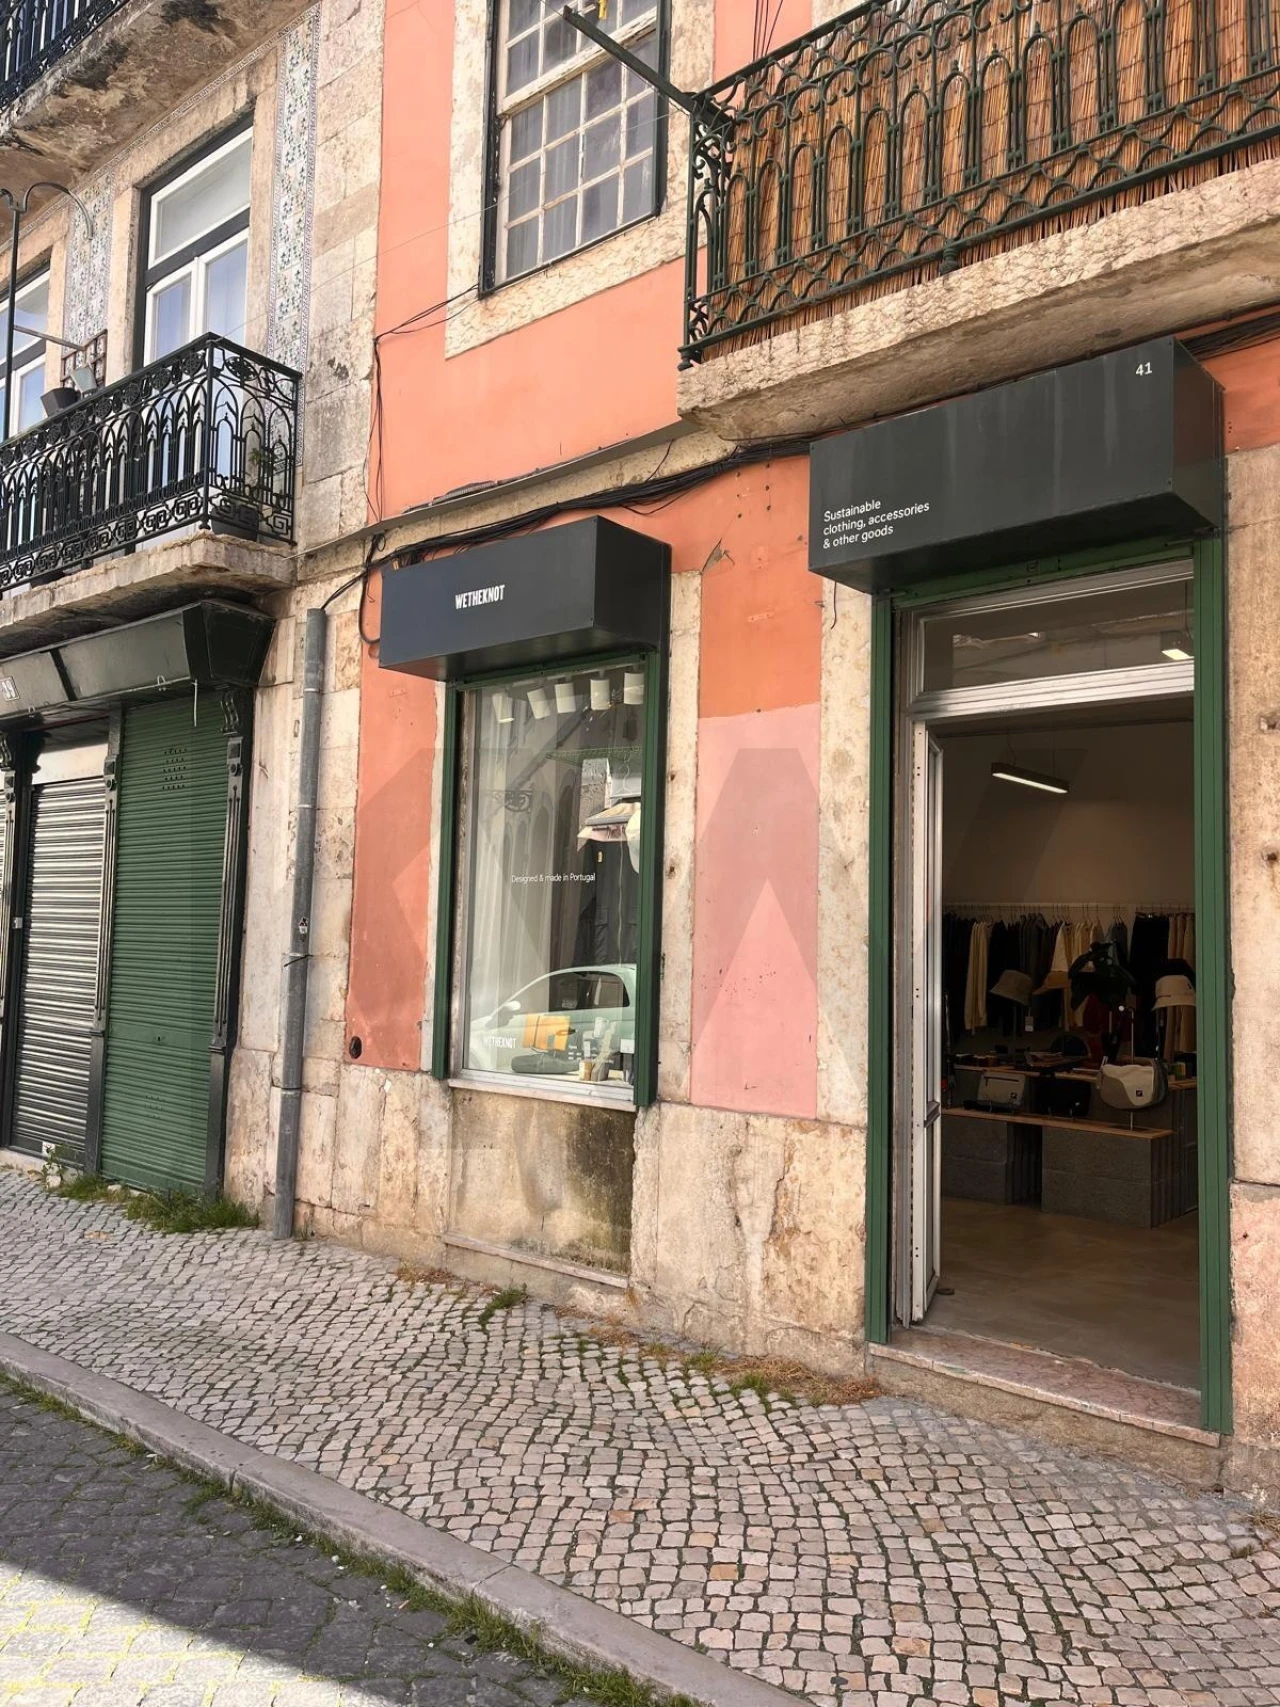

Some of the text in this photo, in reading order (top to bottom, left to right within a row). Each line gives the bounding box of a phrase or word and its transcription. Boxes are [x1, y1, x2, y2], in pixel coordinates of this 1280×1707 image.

[1135, 361, 1153, 376] 41
[823, 499, 882, 522] Sustainable
[823, 502, 930, 536] clothing, accessories
[822, 525, 894, 549] & other goods
[455, 584, 506, 609] WETHEKNOT
[511, 872, 596, 884] Designed & made in Portugal
